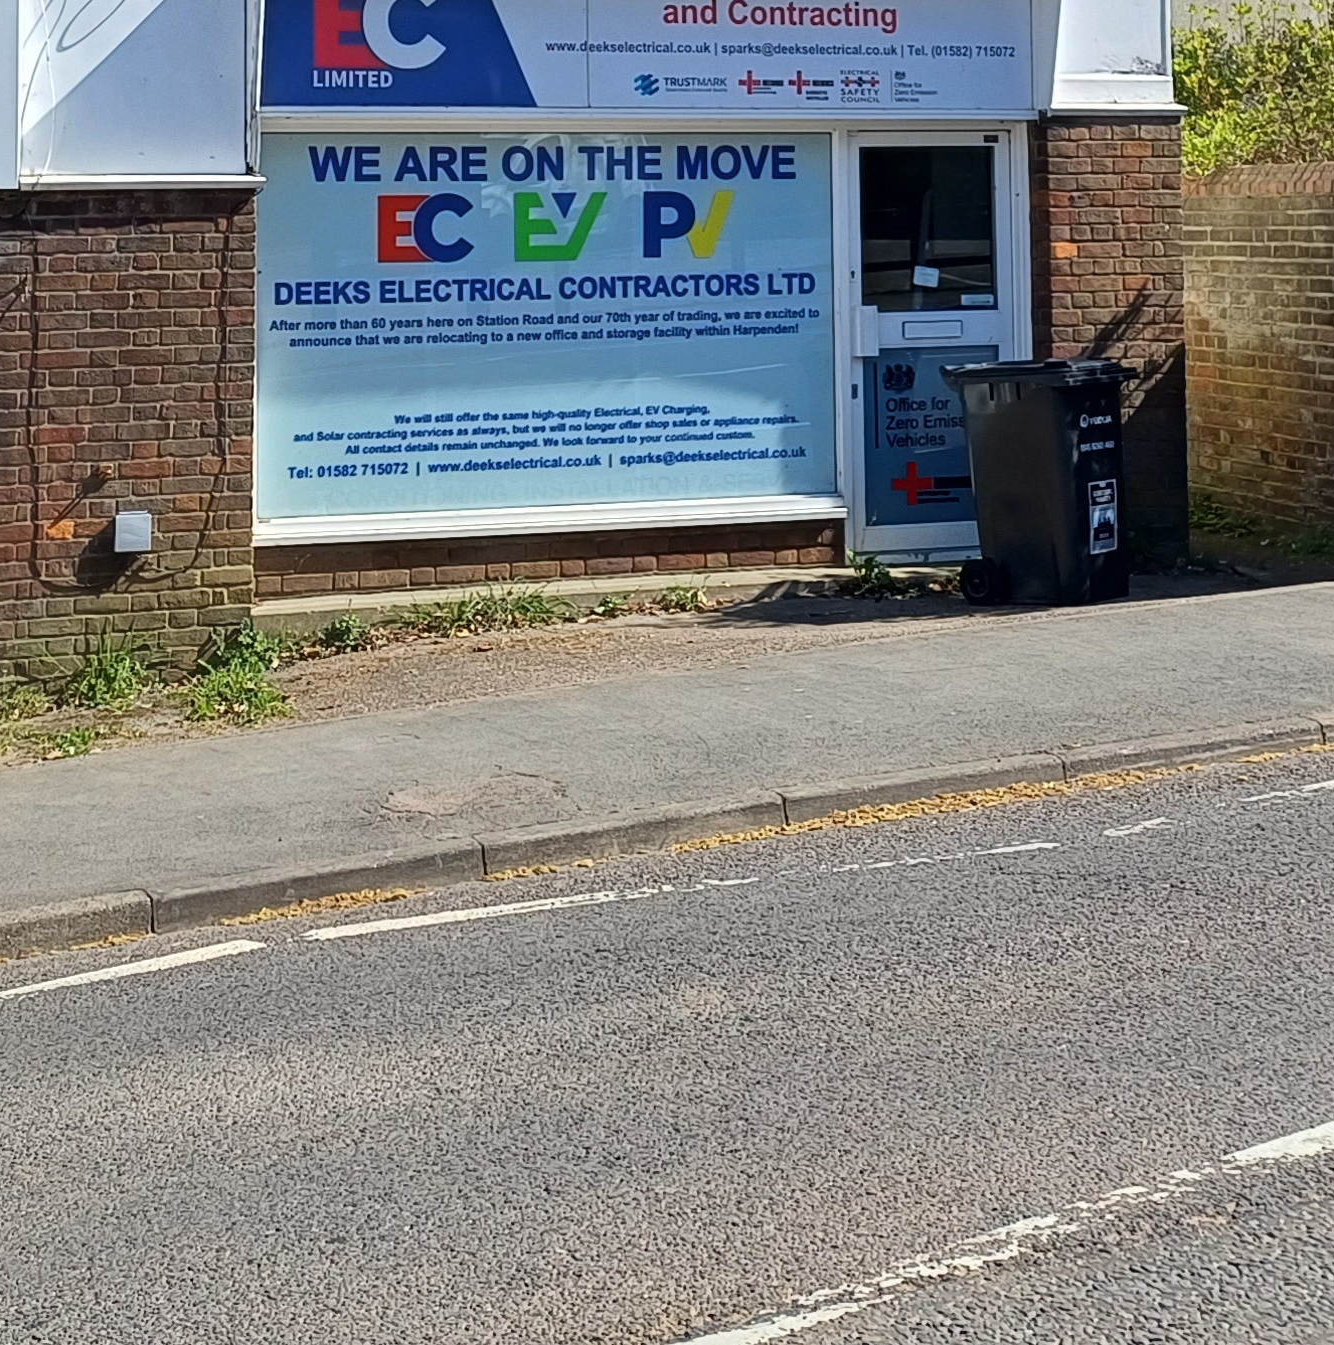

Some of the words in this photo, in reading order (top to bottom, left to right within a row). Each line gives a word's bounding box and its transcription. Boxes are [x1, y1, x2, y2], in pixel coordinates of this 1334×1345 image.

[545, 40, 710, 54] www.deekselectrical.co.uk
[721, 42, 897, 56] sparks@deekselectrical.co.uk
[907, 44, 927, 56] Tel.
[931, 45, 972, 58] (01582)
[977, 46, 1015, 57] 715072
[313, 70, 393, 88] LIMITED
[663, 78, 727, 86] TRUSTMARK
[841, 88, 879, 96] SAFETY
[309, 146, 381, 182] WE
[394, 146, 487, 182] ARE
[501, 146, 563, 181] ON
[579, 146, 663, 180] THE
[677, 145, 796, 180] MOVE
[377, 193, 475, 263] EC
[275, 281, 371, 305] DEEKS
[379, 278, 551, 303] ELECTRICAL
[559, 274, 759, 300] CONTRACTORS
[768, 273, 815, 295] LTD
[269, 320, 300, 331] After
[305, 321, 336, 330] more
[340, 319, 367, 330] than
[371, 318, 386, 329] 60
[389, 318, 423, 332] years
[427, 317, 454, 328] here
[458, 318, 473, 328] on
[477, 314, 518, 326] Station
[523, 314, 553, 326] Road
[557, 313, 579, 324] and
[583, 314, 603, 324] our
[606, 312, 631, 324] 70th
[634, 313, 659, 325] year
[663, 311, 674, 322] of
[677, 310, 721, 323] trading,
[725, 311, 741, 320] we
[744, 311, 761, 320] are
[765, 308, 805, 319] excited
[809, 308, 819, 318] to
[289, 337, 352, 348] announce
[356, 334, 379, 346] that
[383, 336, 400, 344] we
[404, 336, 423, 344] are
[427, 331, 487, 344] relocating
[491, 332, 503, 342] to
[507, 333, 513, 342] a
[517, 332, 541, 340] new
[545, 329, 577, 340] office
[581, 329, 603, 340] and
[607, 328, 651, 340] storage
[654, 326, 693, 339] facility
[695, 325, 730, 336] within
[733, 324, 799, 337] Harpenden!
[885, 397, 927, 412] Office
[931, 396, 950, 410] for
[394, 415, 411, 424] We
[415, 414, 432, 423] will
[435, 413, 453, 422] still
[456, 412, 479, 422] offer
[483, 412, 499, 421] the
[502, 412, 529, 421] same
[532, 409, 591, 422] high-quality
[594, 407, 643, 418] Electrical,
[646, 406, 660, 415] EV
[885, 415, 919, 430] Zero
[923, 413, 965, 429] Emiss
[293, 432, 313, 442] and
[317, 431, 345, 441] Solar
[347, 429, 407, 440] contracting
[411, 428, 453, 438] services
[457, 428, 468, 436] as
[471, 426, 509, 437] always,
[513, 425, 529, 434] but
[549, 424, 566, 432] will
[569, 424, 581, 432] no
[585, 422, 617, 432] longer
[619, 420, 642, 430] offer
[645, 419, 669, 430] shop
[673, 418, 697, 427] sales
[713, 416, 759, 428] appliance
[345, 445, 359, 455] All
[363, 444, 402, 454] contact
[405, 442, 439, 452] details
[443, 440, 477, 451] remain
[481, 438, 541, 450] unchanged.
[543, 438, 559, 446] We
[562, 437, 583, 446] look
[586, 435, 624, 444] forward
[627, 435, 637, 444] to
[639, 436, 662, 446] your
[665, 432, 713, 442] continued
[716, 431, 755, 440] custom.
[885, 432, 945, 448] Vehicles
[287, 466, 313, 478] Tel:
[317, 464, 357, 478] 01582
[361, 462, 409, 476] 715072
[428, 454, 602, 473] www.deekselectrical.co.uk
[620, 446, 806, 467] sparks@deekselectrical.co.uk
